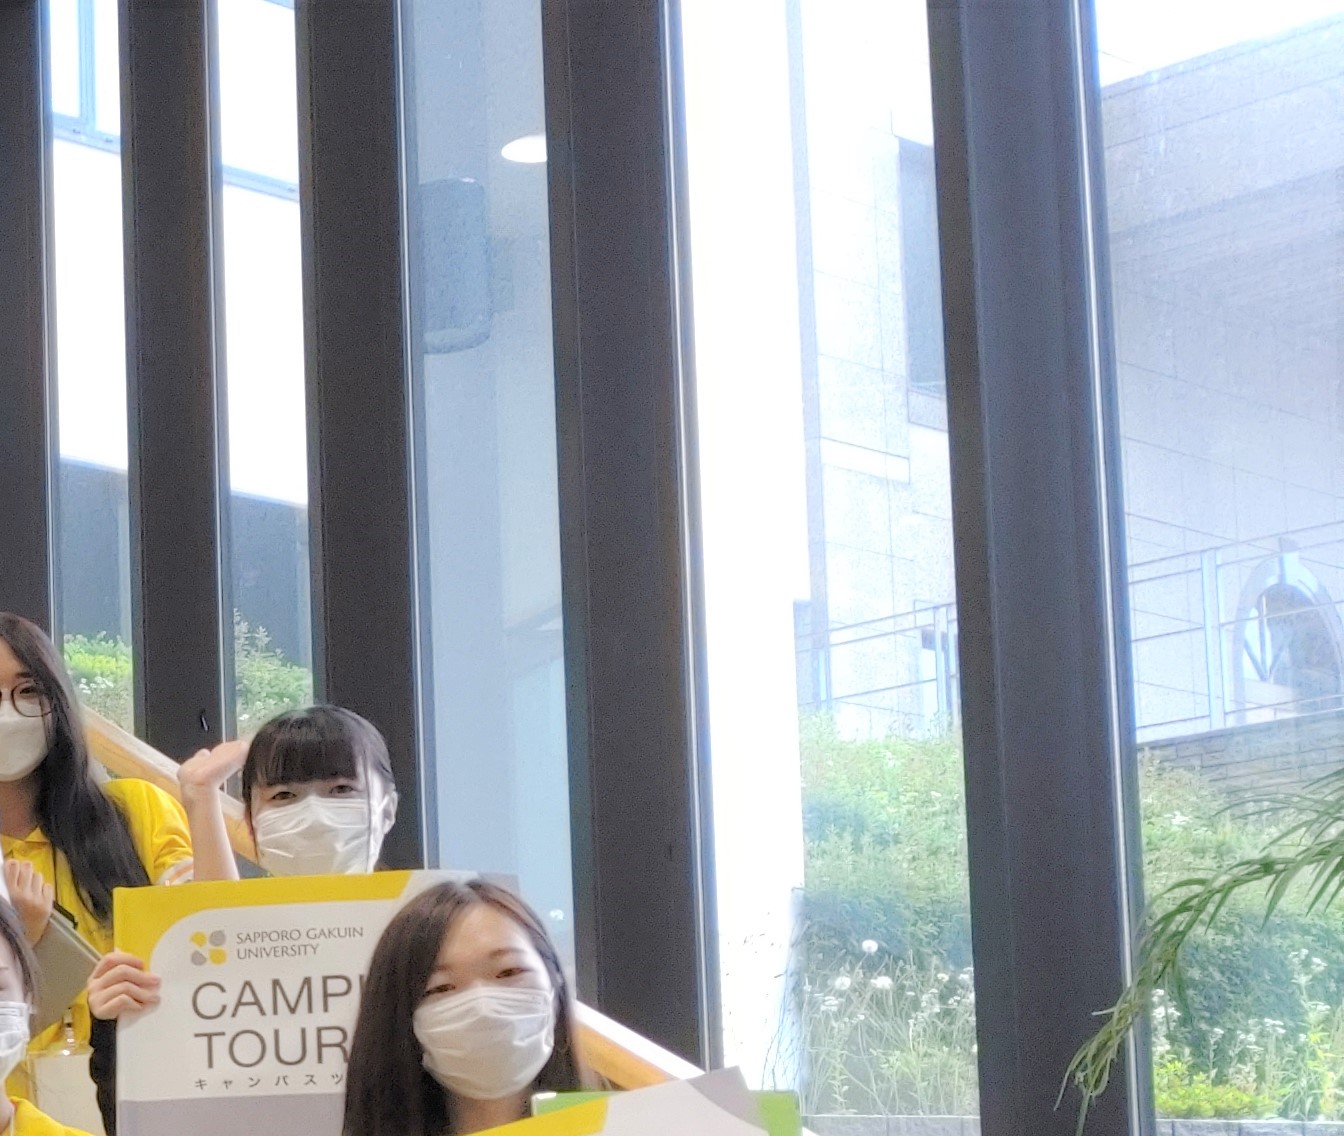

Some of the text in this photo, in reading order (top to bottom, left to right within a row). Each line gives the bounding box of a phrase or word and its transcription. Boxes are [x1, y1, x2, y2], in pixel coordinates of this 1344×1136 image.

[236, 926, 364, 945] SAPPORO GAKUIN
[236, 943, 320, 961] UNIVERSITY
[194, 1025, 349, 1069] TOUR
